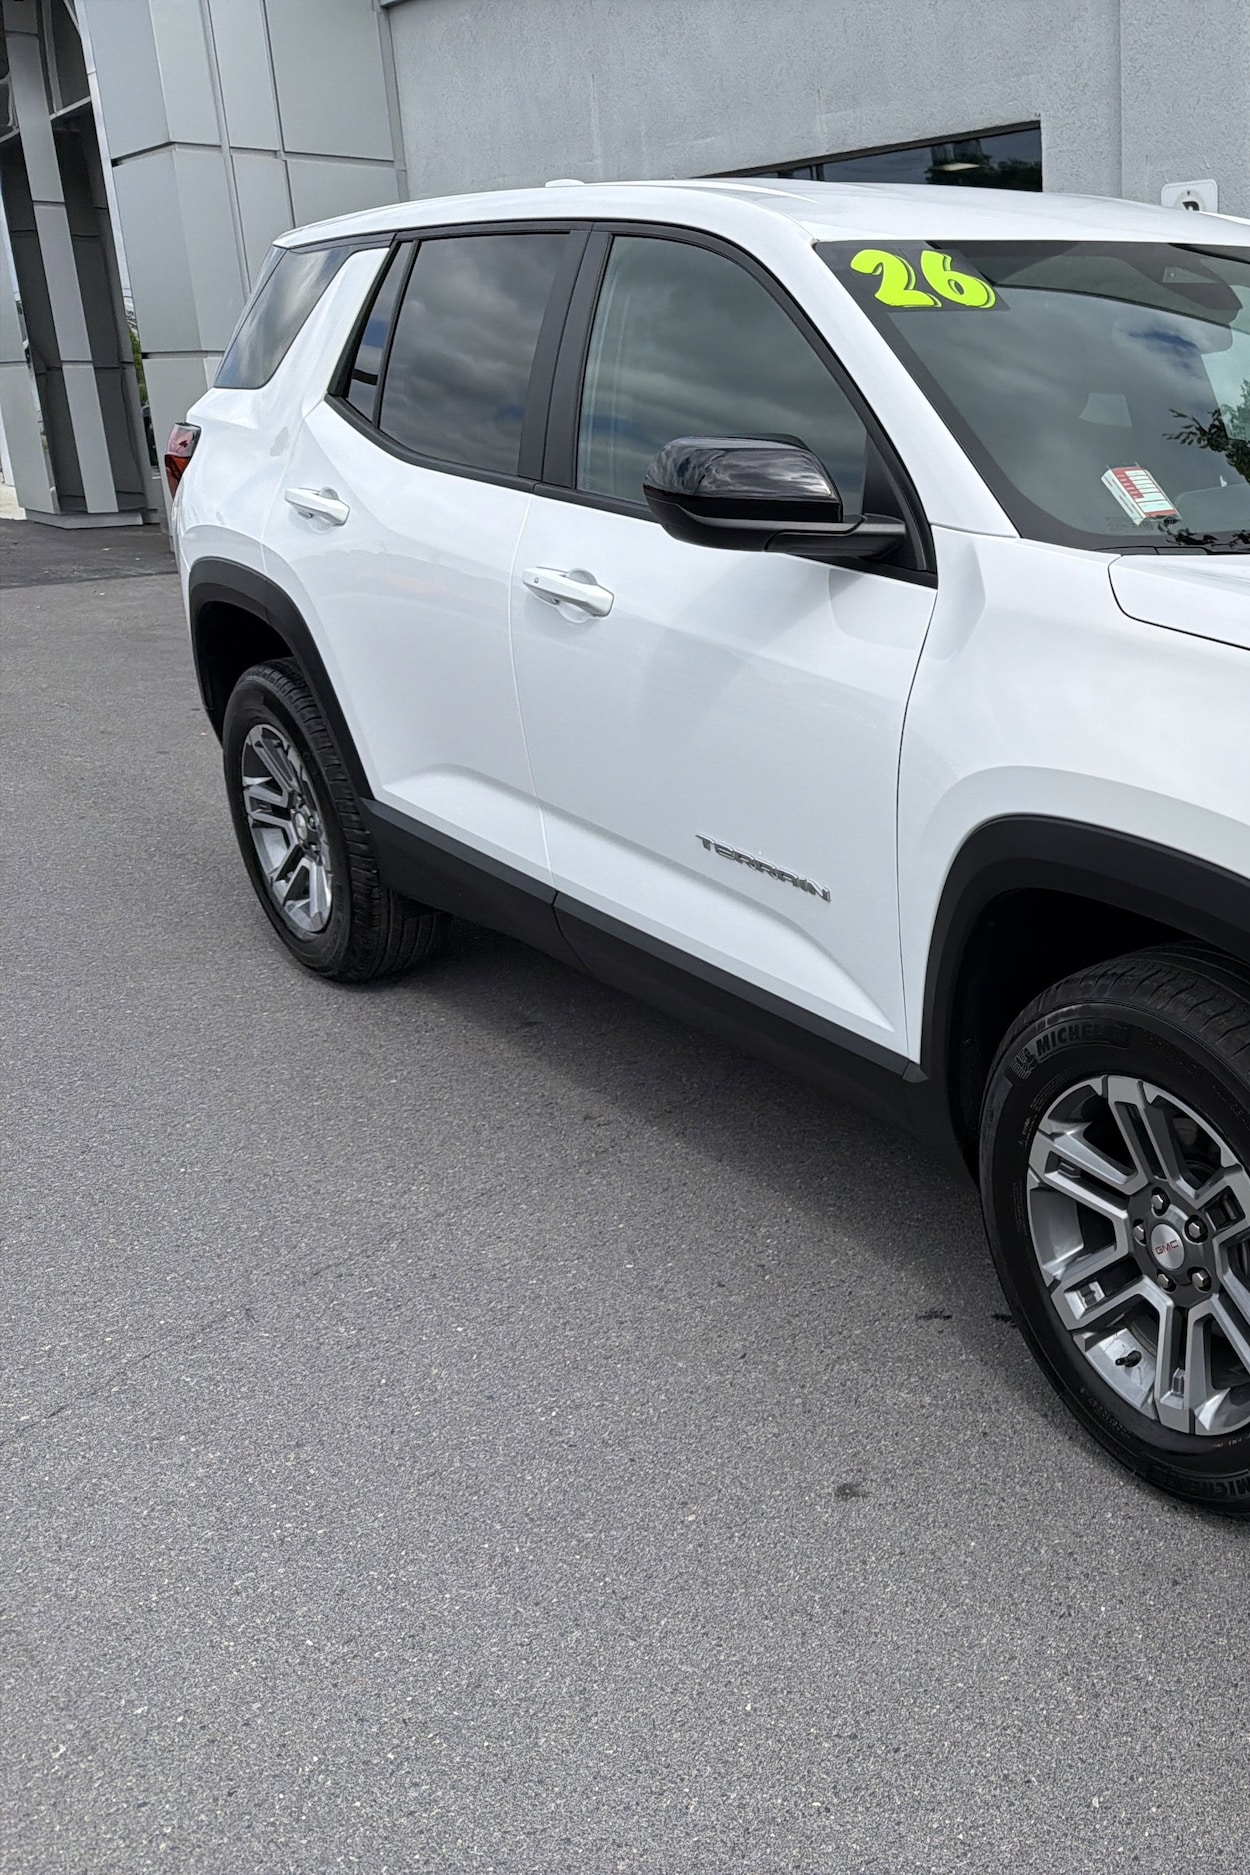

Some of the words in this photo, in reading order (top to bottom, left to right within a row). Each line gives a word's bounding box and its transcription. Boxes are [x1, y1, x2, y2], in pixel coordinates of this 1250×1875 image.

[850, 248, 996, 310] 26
[695, 832, 831, 902] TERRAIN
[1155, 1239, 1179, 1255] GMC
